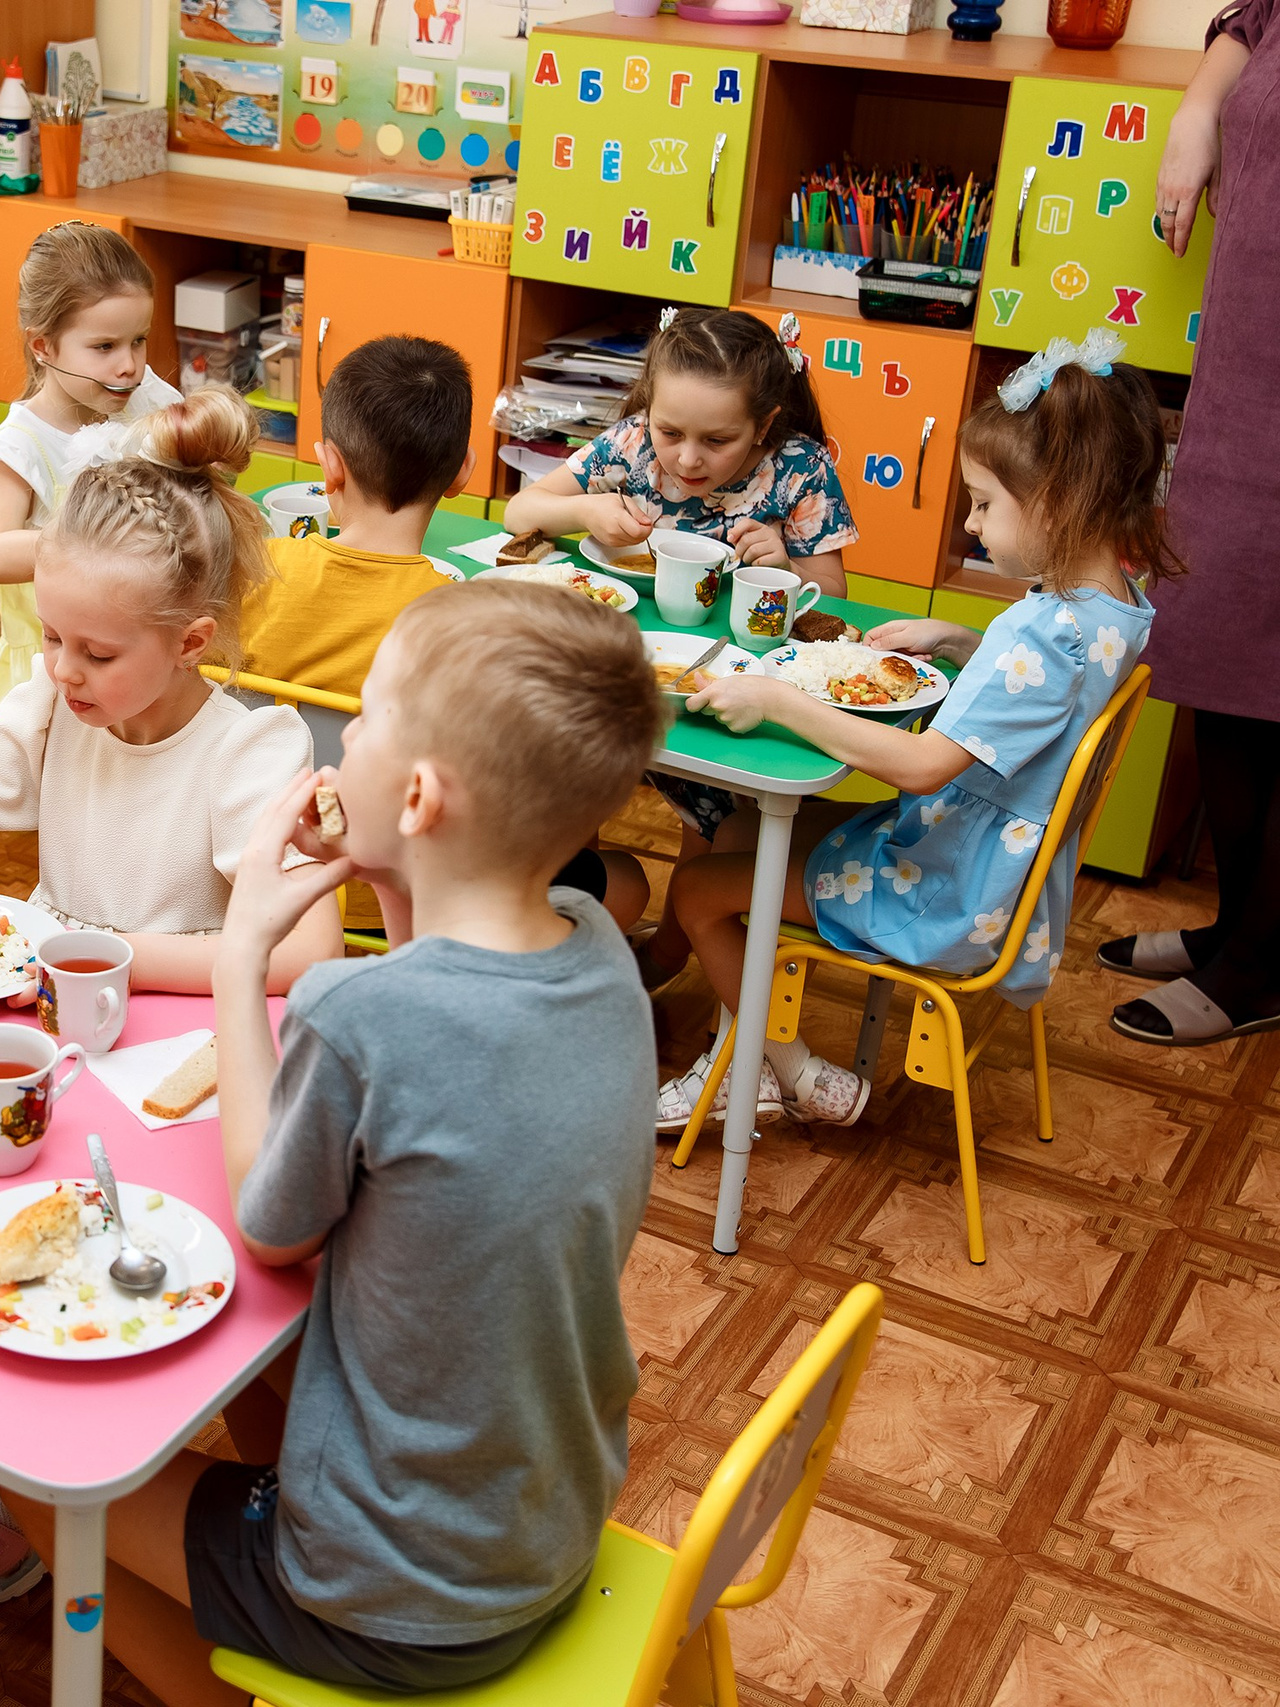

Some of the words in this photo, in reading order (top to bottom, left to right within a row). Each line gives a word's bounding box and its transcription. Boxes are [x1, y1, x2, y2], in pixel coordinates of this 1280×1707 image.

[308, 75, 334, 98] 19
[401, 83, 429, 107] 20
[533, 51, 560, 85] А
[579, 68, 603, 102] Б
[624, 56, 649, 92] В
[669, 72, 691, 107] Г
[714, 68, 740, 104] Д
[1047, 120, 1084, 158] Л
[1104, 102, 1147, 143] М
[553, 135, 574, 169] Е
[601, 141, 621, 181] Ё
[648, 139, 687, 174] Ж
[1037, 195, 1072, 234] П
[1096, 179, 1128, 217] Р
[524, 210, 545, 243] З
[564, 228, 590, 261] И
[623, 208, 649, 249] Й
[671, 239, 700, 274] К
[990, 289, 1022, 325] У
[1051, 262, 1089, 298] Ф
[1106, 287, 1145, 325] Х
[824, 339, 862, 378] Щ
[882, 362, 910, 397] Ъ
[864, 454, 903, 488] Ю
